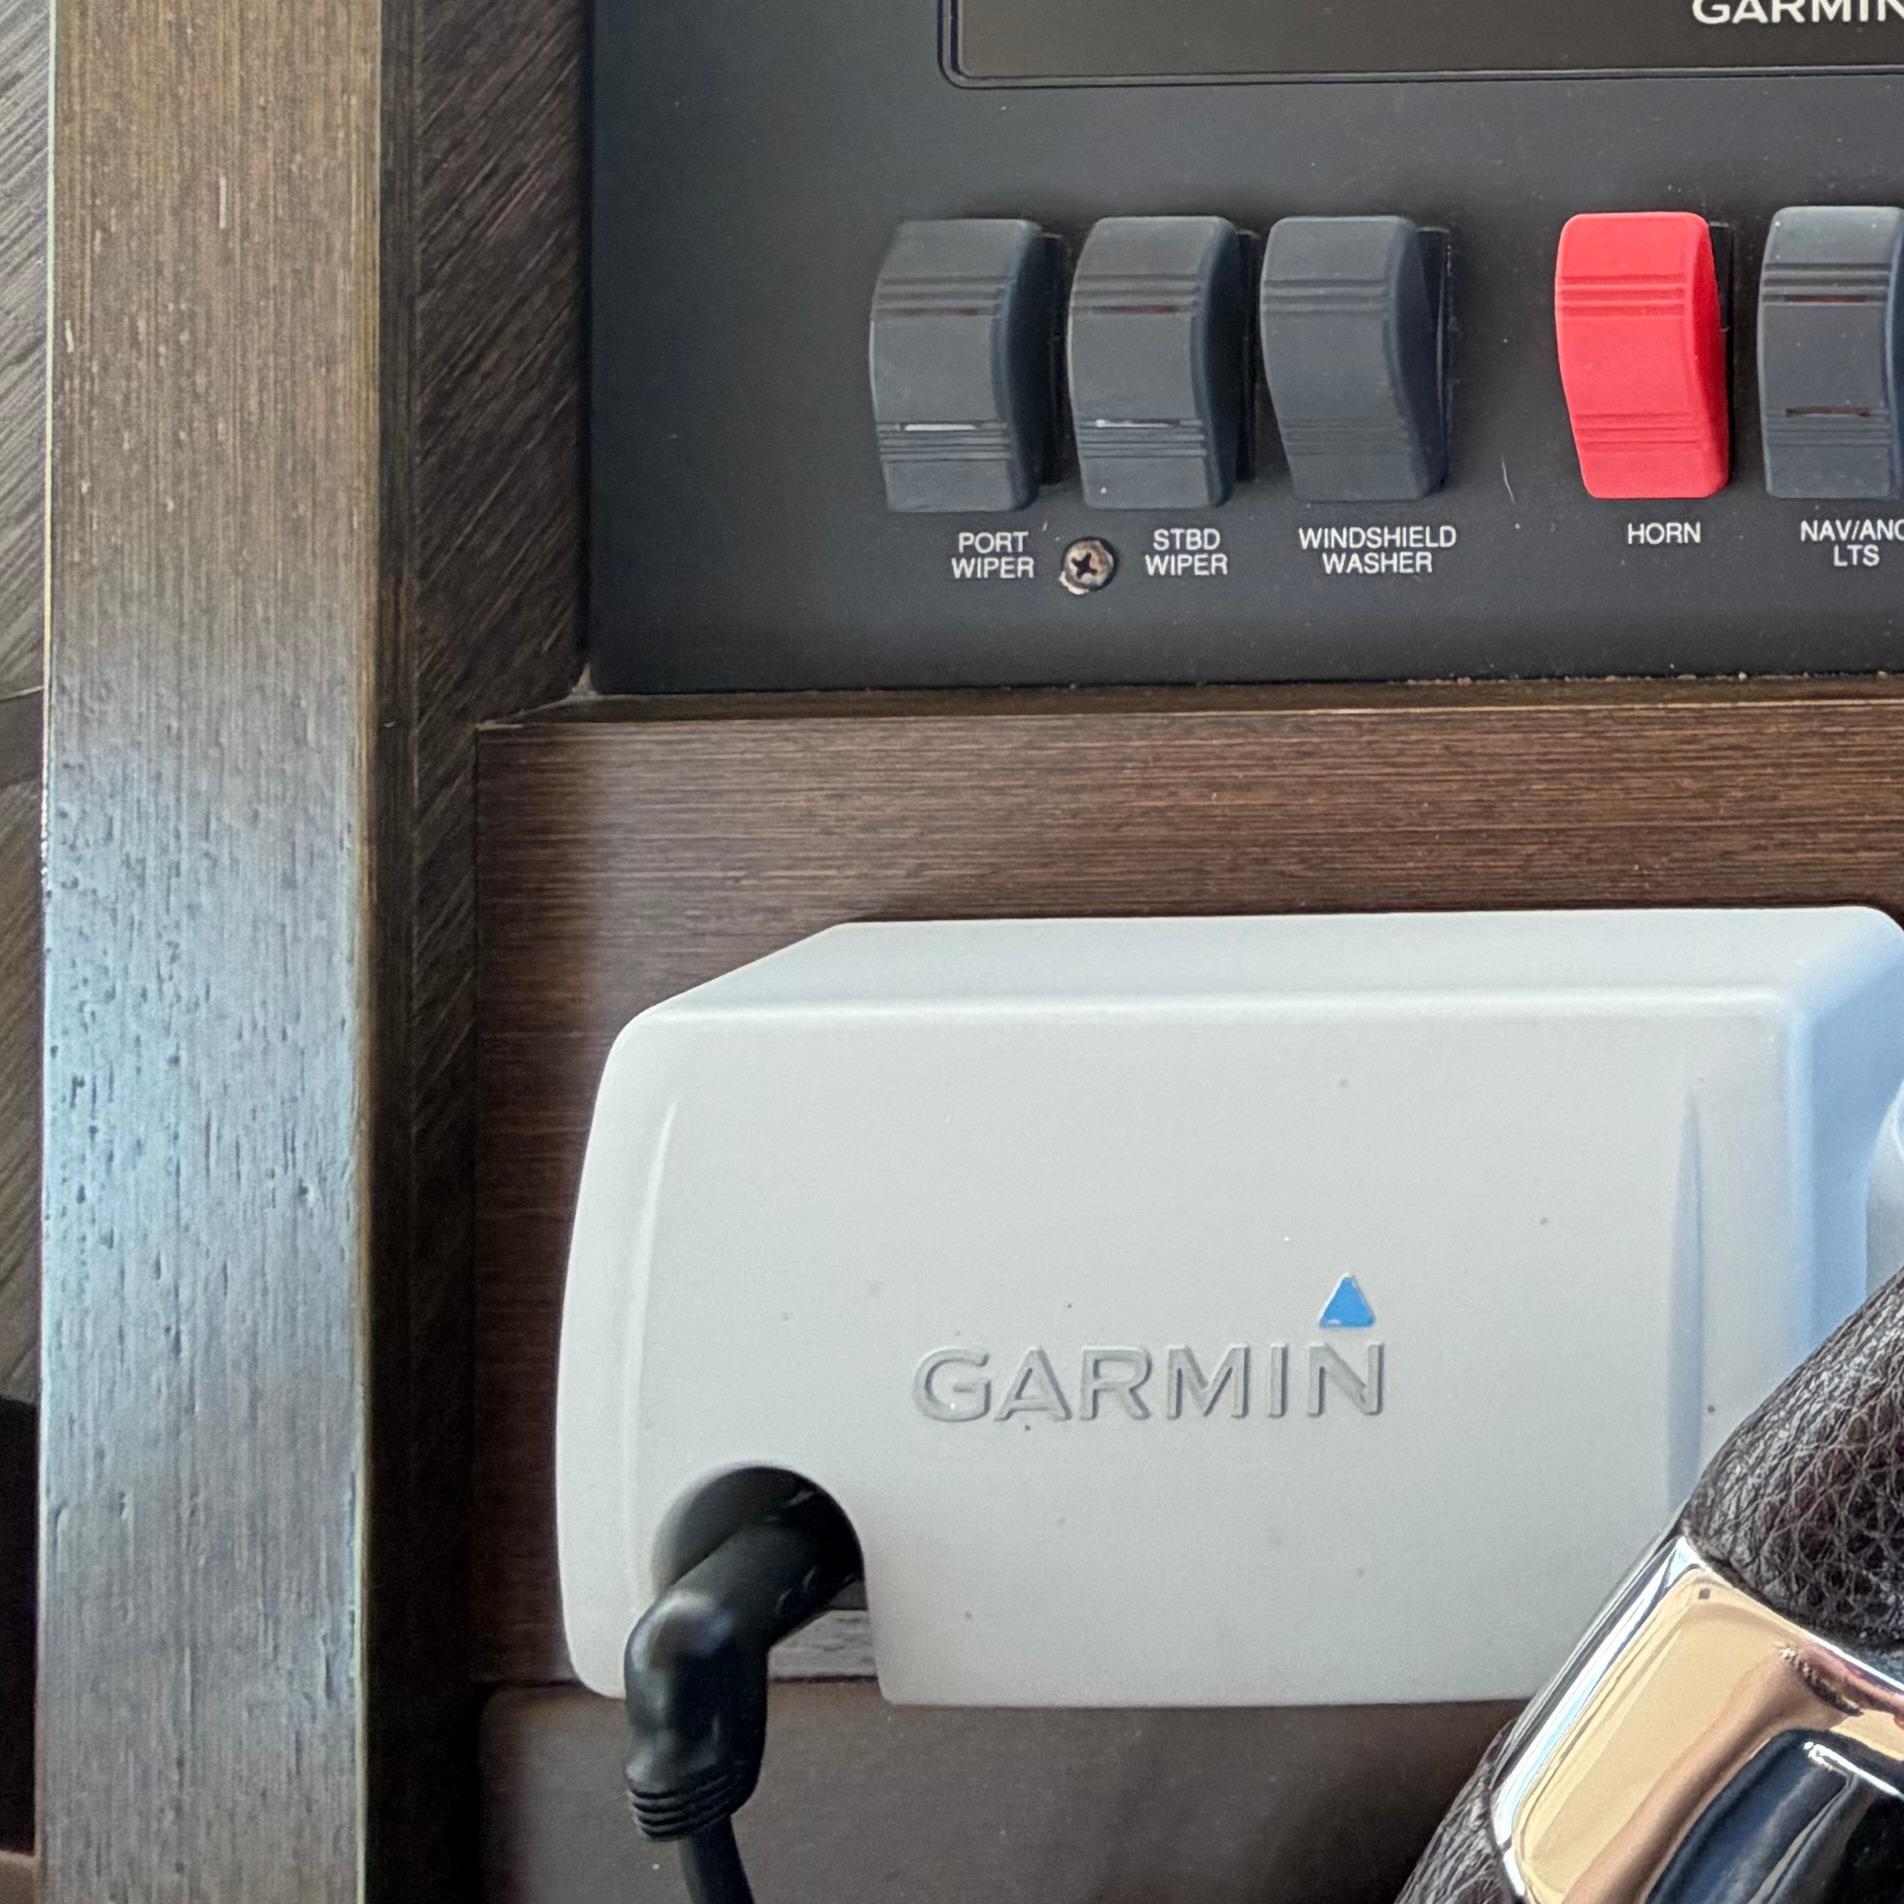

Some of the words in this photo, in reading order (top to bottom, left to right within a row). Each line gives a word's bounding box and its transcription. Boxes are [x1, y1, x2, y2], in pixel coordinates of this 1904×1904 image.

[958, 531, 1029, 554] PORT
[1153, 528, 1221, 551] STBD
[1299, 526, 1457, 549] WINDSHIELD
[1628, 522, 1701, 545] HORN
[1146, 554, 1227, 576] WIPER
[1322, 552, 1433, 574] WASHER
[1833, 545, 1880, 567] LTS
[951, 557, 1034, 579] WIPER
[911, 1342, 1385, 1423] GARMIN
